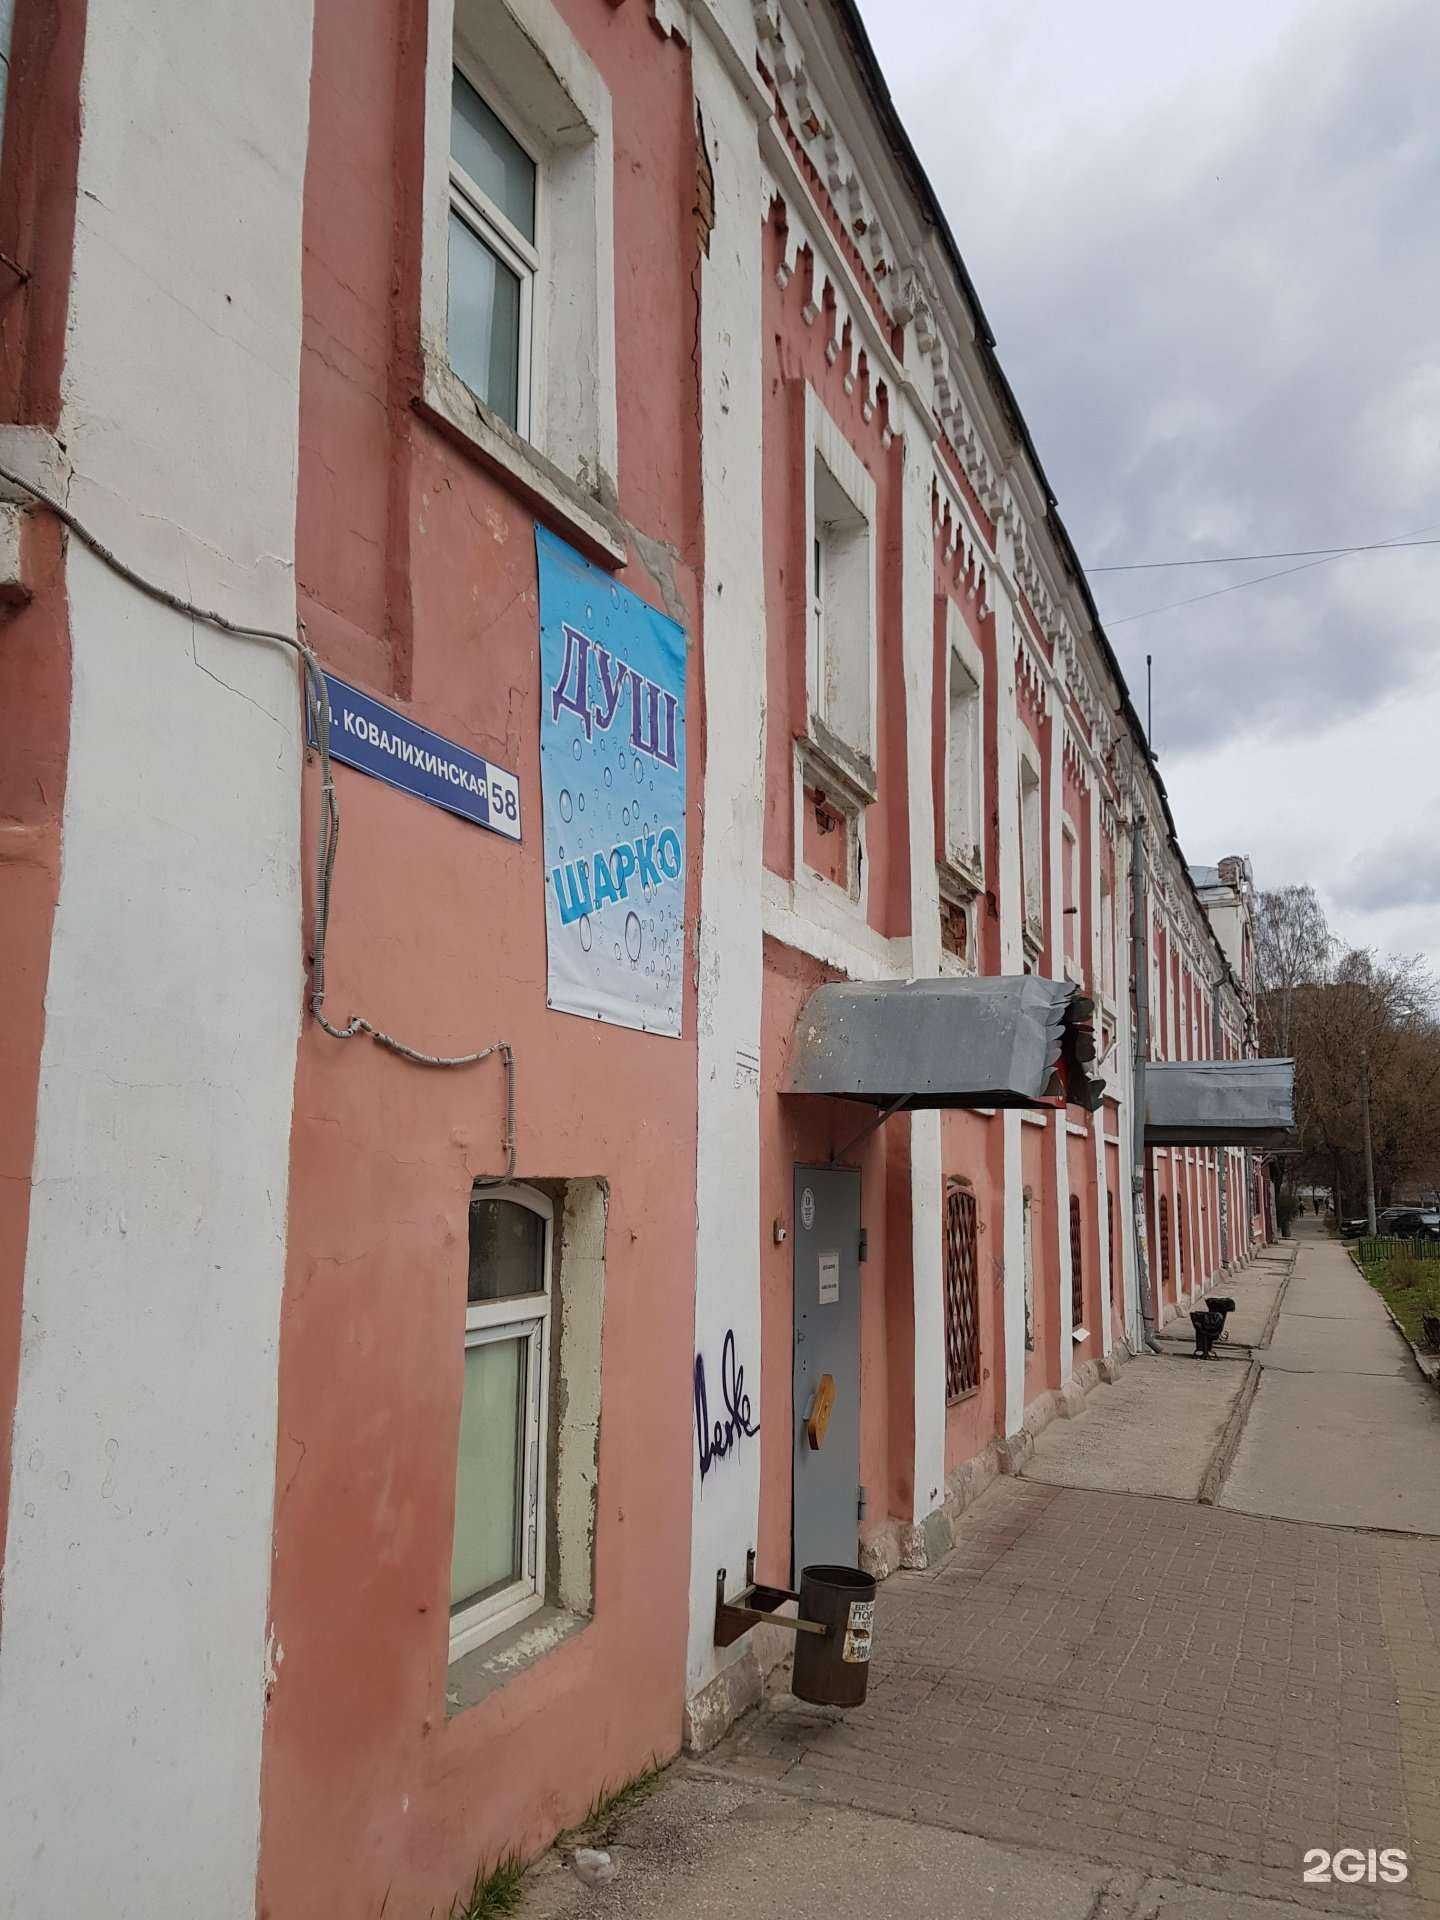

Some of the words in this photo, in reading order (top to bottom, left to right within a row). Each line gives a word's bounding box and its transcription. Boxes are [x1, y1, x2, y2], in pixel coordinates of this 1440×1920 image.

[552, 621, 679, 772] ДУШ
[343, 708, 488, 799] КОВАЛИХИНСКАЯ
[491, 781, 517, 821] 58
[551, 826, 682, 928] ШАРКО
